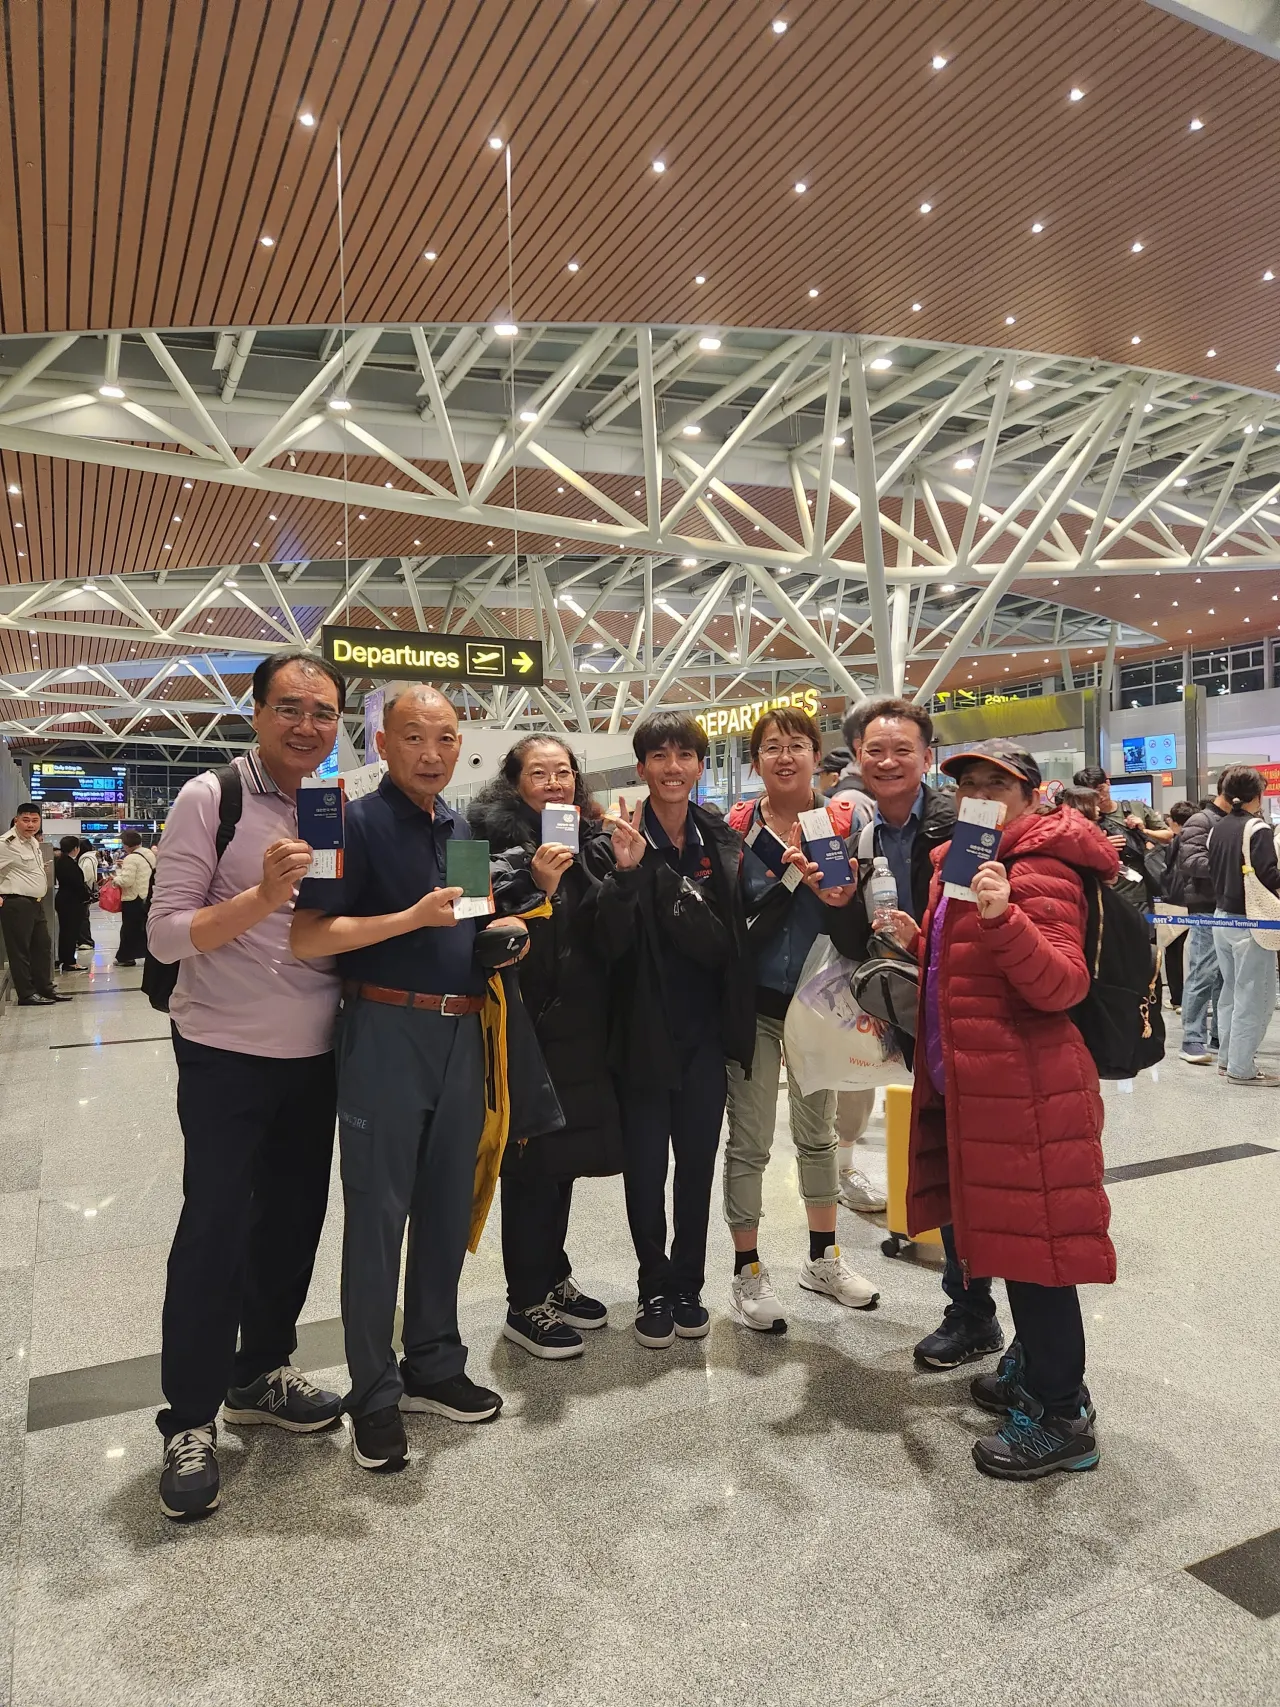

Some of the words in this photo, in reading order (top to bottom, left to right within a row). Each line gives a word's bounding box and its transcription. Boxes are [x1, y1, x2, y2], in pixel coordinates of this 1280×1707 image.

[333, 639, 460, 669] Departures
[1184, 918, 1200, 926] Nang
[1200, 918, 1234, 927] International
[1234, 919, 1259, 928] Terminal
